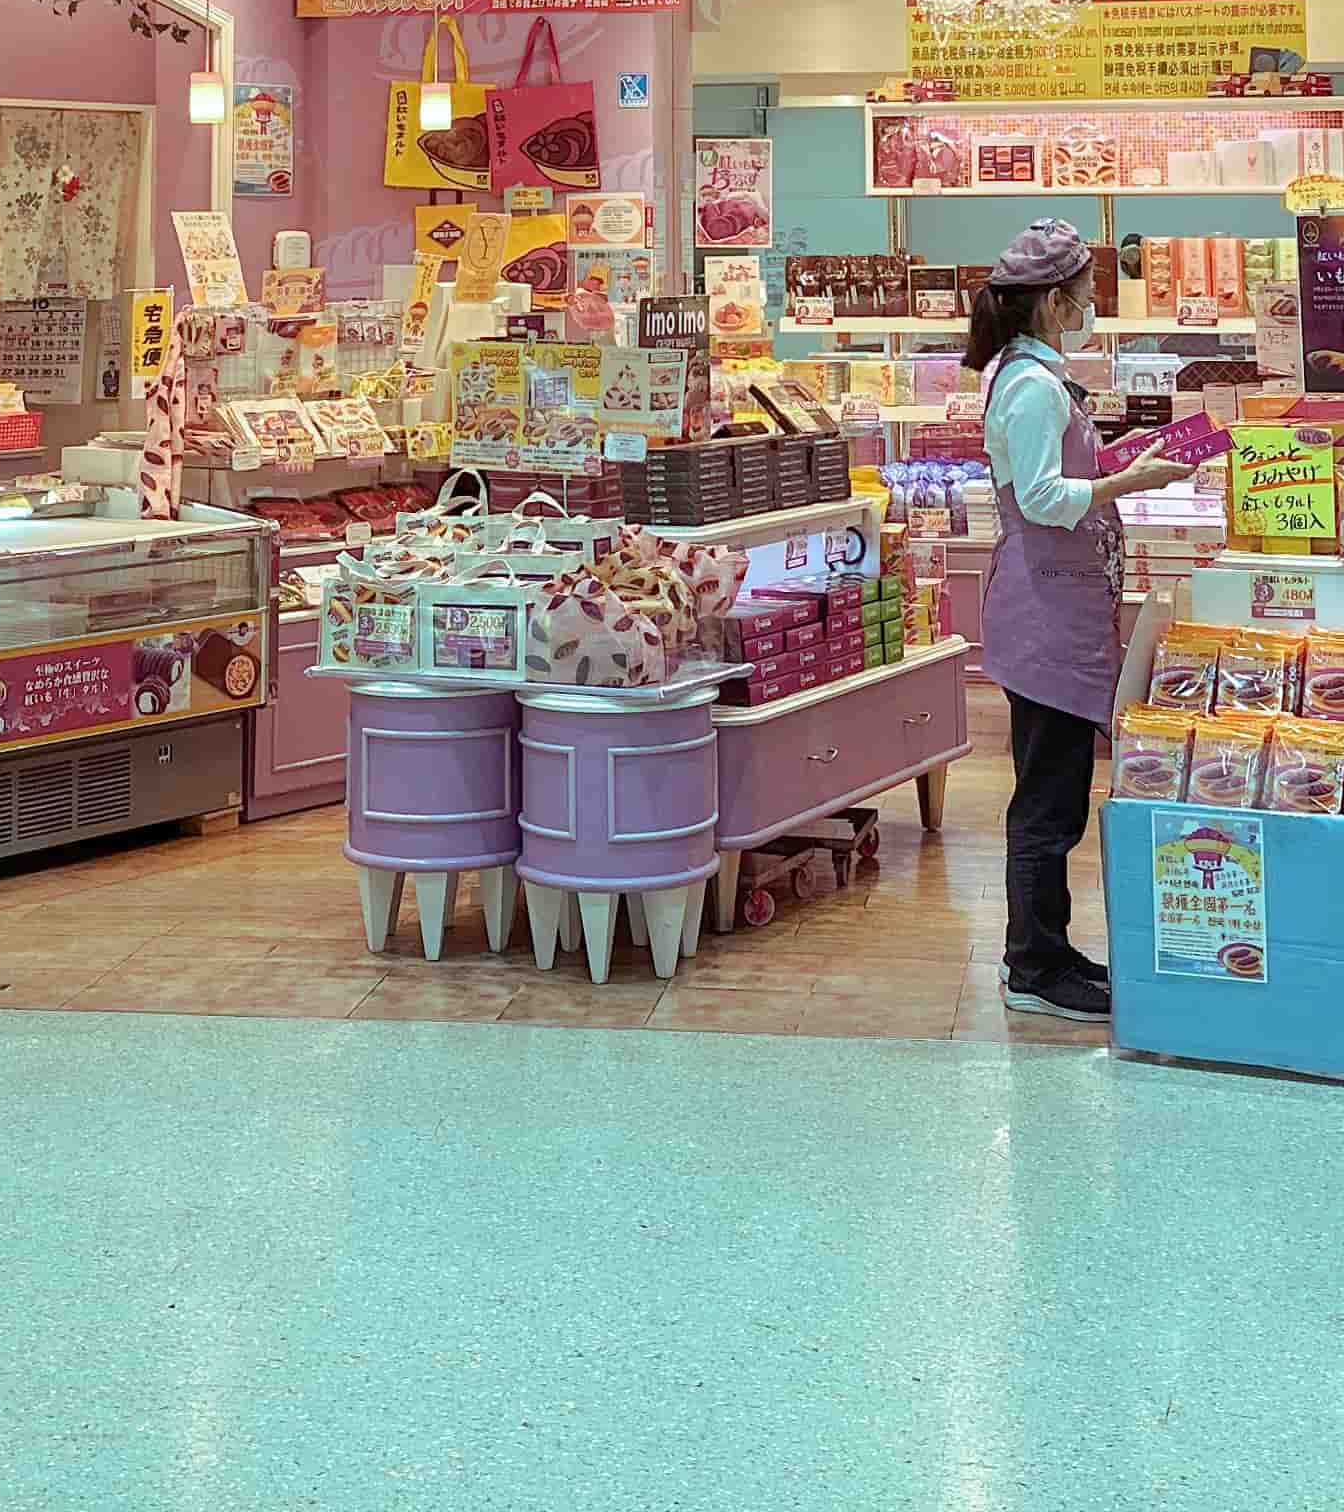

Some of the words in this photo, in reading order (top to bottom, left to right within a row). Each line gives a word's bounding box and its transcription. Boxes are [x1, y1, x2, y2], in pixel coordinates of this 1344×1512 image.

[32, 298, 50, 310] 10
[645, 302, 675, 337] imo
[678, 302, 705, 336] imo
[142, 303, 164, 367] 宅急便
[1276, 512, 1326, 531] 3個入
